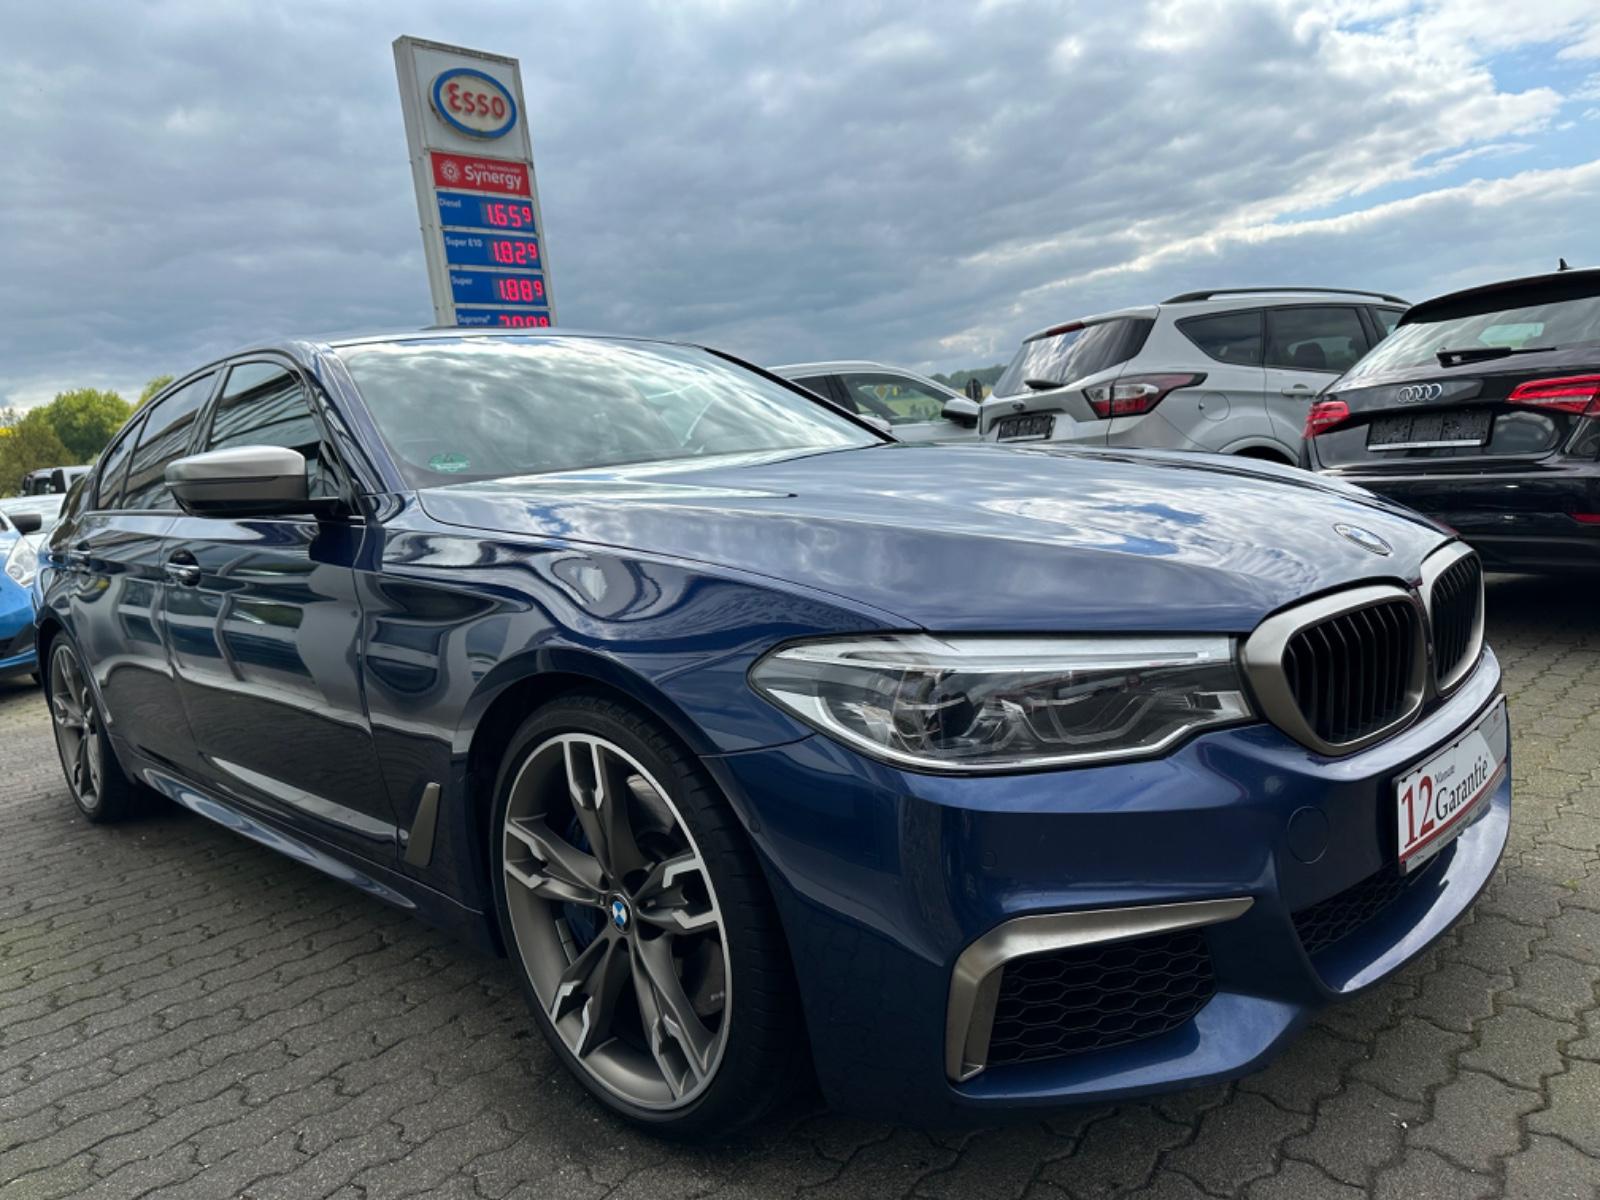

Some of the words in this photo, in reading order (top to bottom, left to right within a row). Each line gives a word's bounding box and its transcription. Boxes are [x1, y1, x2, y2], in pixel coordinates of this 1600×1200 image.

[464, 165, 522, 191] Synergy
[438, 198, 462, 209] Diesel
[445, 237, 467, 248] Super
[468, 239, 483, 248] E10
[451, 275, 473, 286] Super
[1435, 755, 1488, 820] Garantie
[1401, 775, 1435, 849] 12
